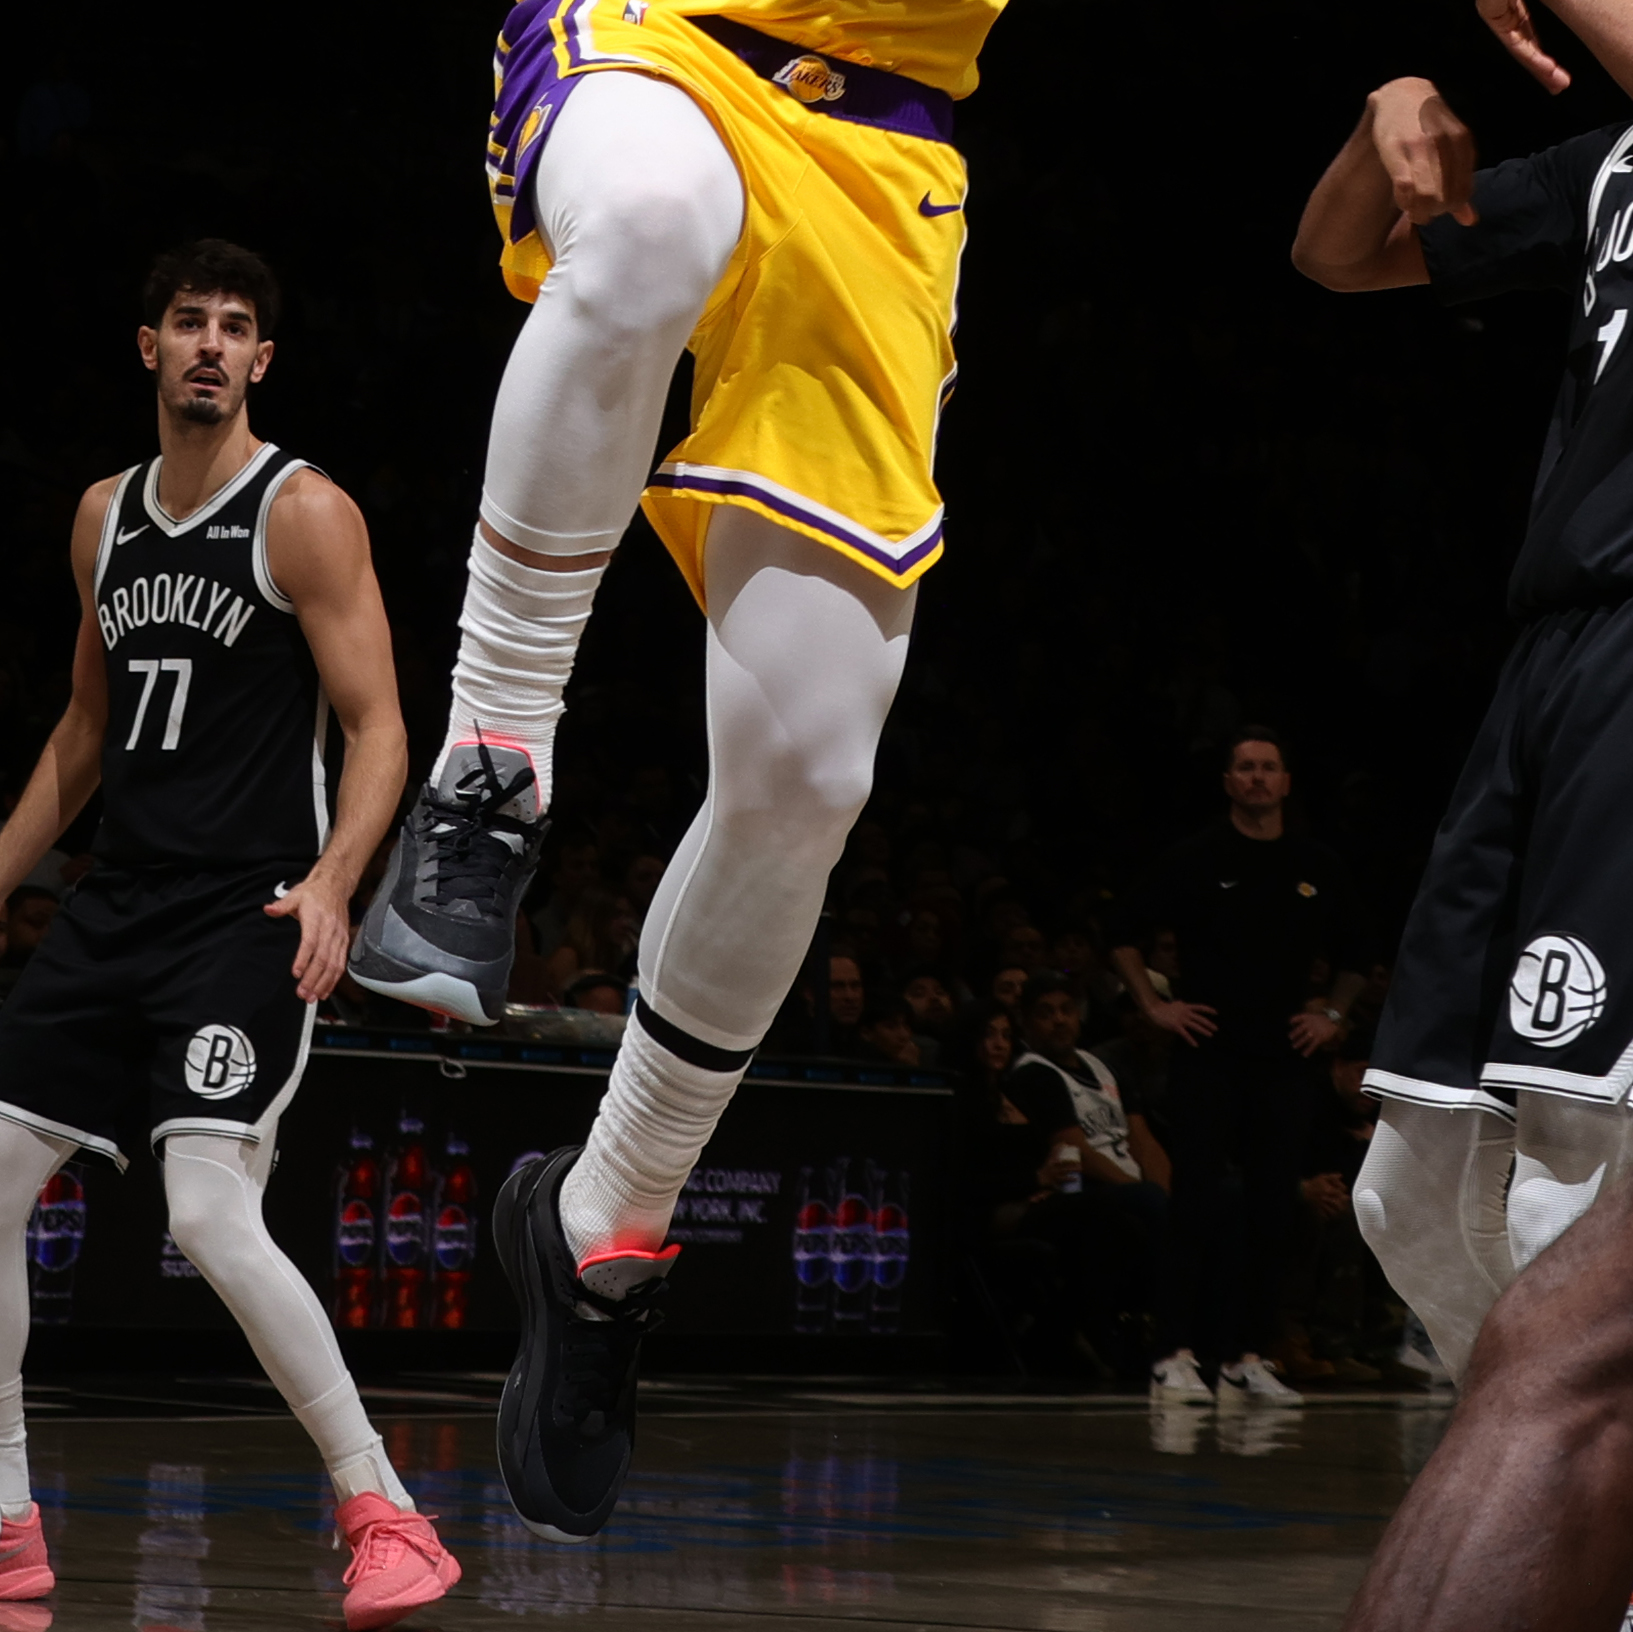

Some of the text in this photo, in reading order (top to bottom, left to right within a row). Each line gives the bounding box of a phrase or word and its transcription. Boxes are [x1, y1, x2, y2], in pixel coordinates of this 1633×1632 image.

[1591, 308, 1629, 386] 1
[97, 572, 256, 652] BROOKLYN
[125, 658, 194, 752] 77
[1532, 948, 1571, 1031] B
[203, 1033, 234, 1088] B
